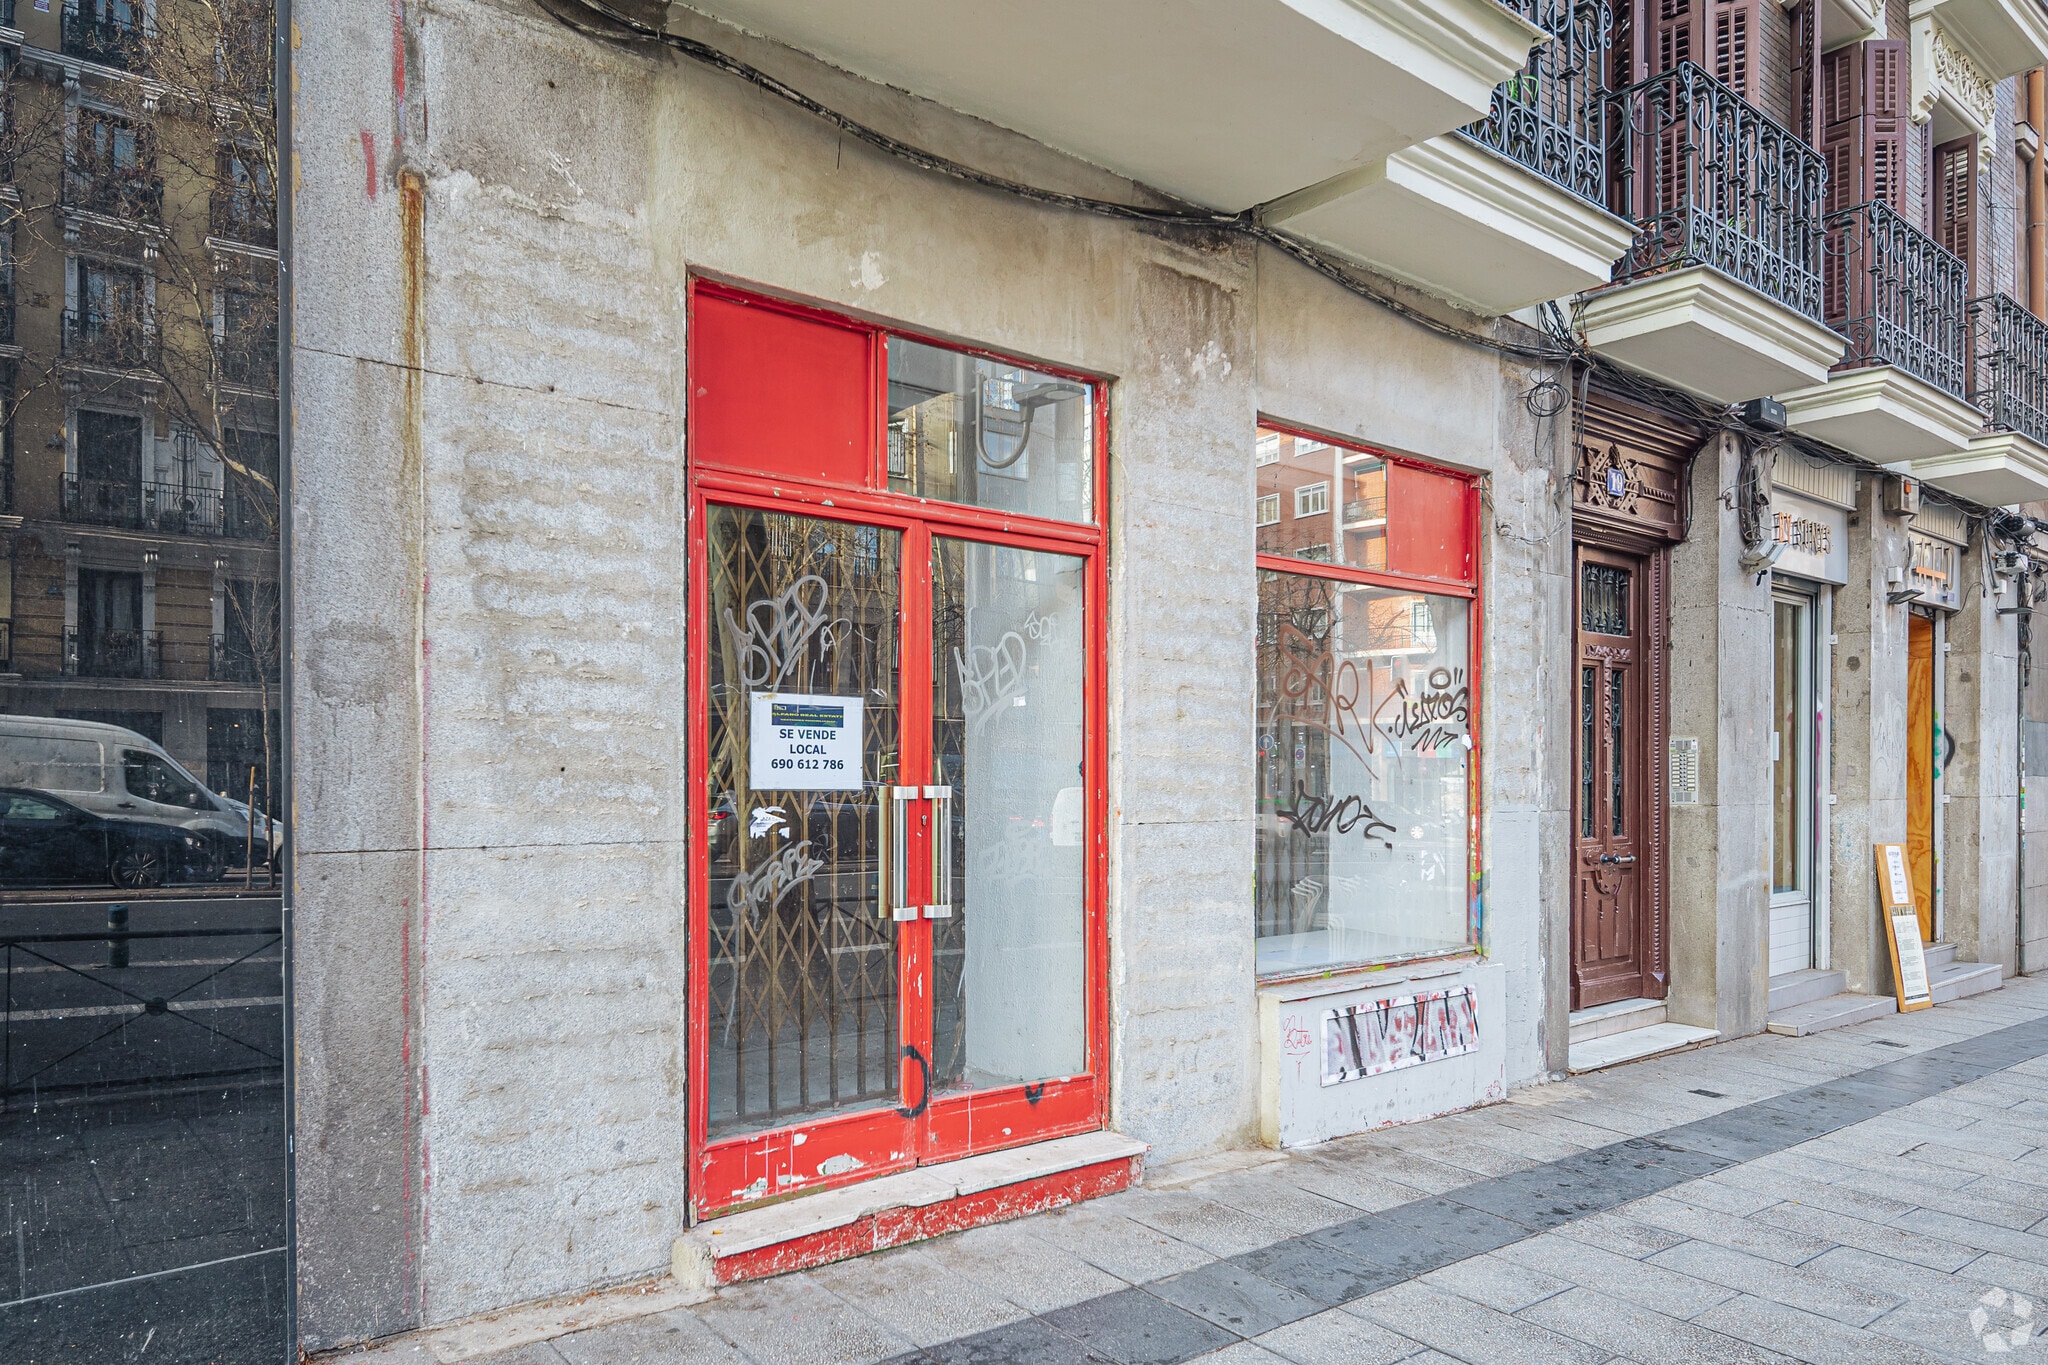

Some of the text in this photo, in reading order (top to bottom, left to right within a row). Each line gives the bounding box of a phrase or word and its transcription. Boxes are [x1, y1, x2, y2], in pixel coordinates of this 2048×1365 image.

[1611, 472, 1623, 492] 19
[1778, 511, 1793, 544] BY
[779, 728, 837, 740] SE VENDE
[789, 744, 827, 755] LOCAL
[771, 758, 844, 770] 690 612 786
